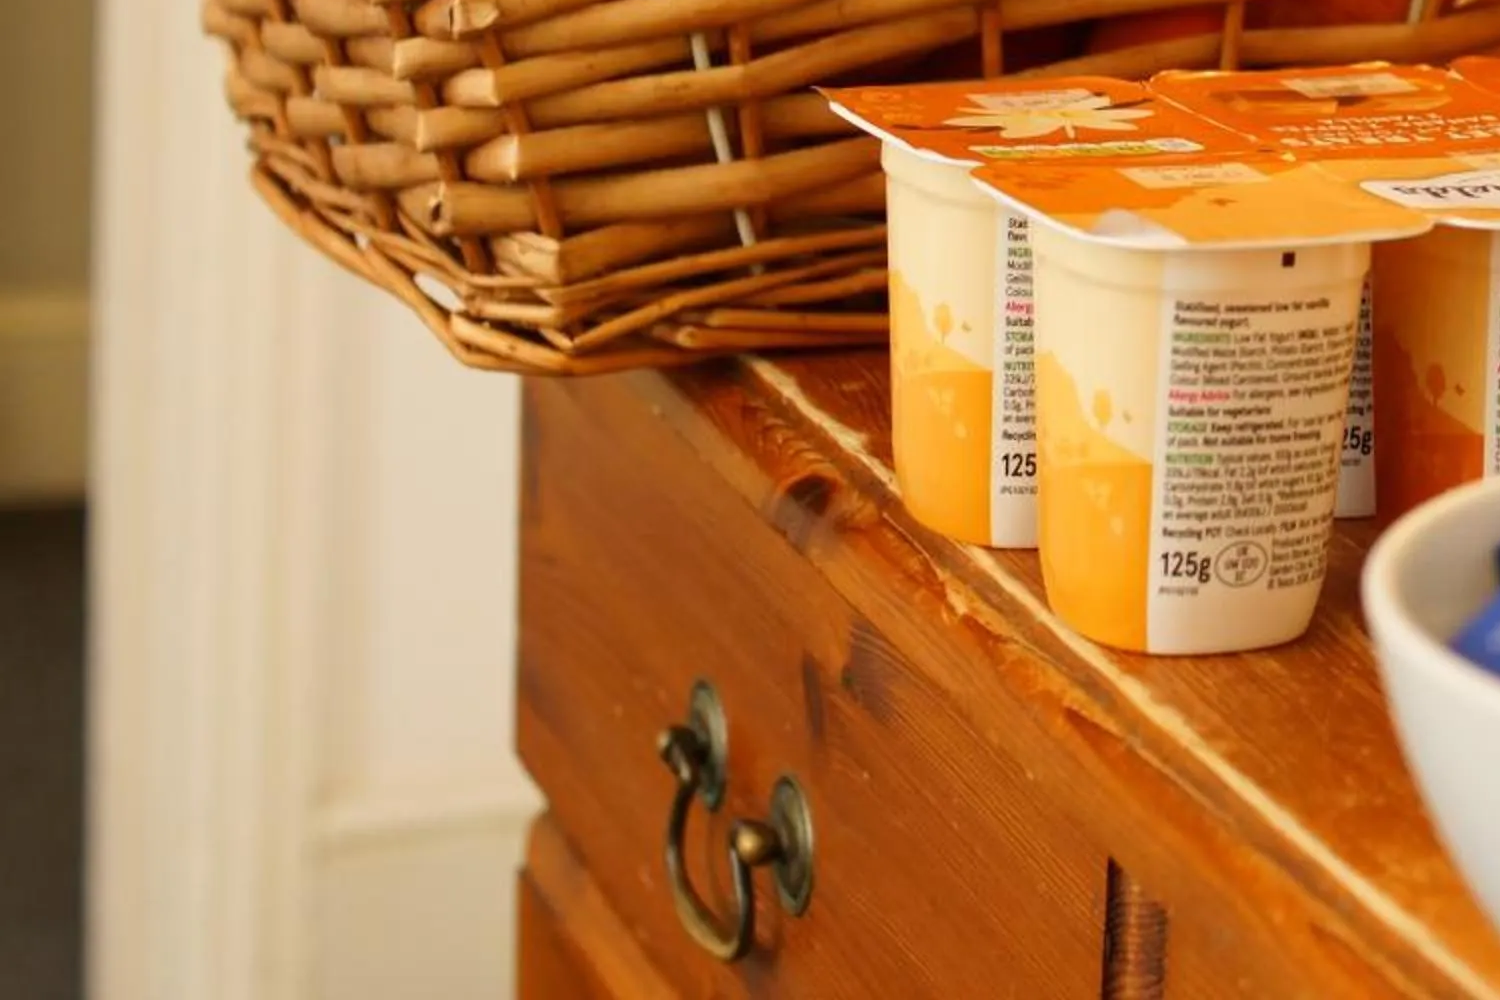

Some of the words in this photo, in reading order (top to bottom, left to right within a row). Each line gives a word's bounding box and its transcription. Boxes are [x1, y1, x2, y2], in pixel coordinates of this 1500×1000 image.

[1005, 286, 1032, 297] Colou
[1005, 316, 1033, 326] Suitab
[1168, 388, 1200, 403] Allergy
[1168, 406, 1205, 417] Suitable
[1207, 405, 1220, 416] for
[1223, 406, 1271, 418] vegetarians
[1211, 423, 1232, 433] Keep
[1002, 429, 1036, 443] Recyclin
[1203, 436, 1219, 446] Not
[1221, 435, 1253, 446] suitable
[1256, 434, 1268, 444] for
[1270, 433, 1291, 443] home
[1342, 425, 1371, 456] 25g
[1002, 452, 1037, 477] 125
[1162, 528, 1202, 541] Recycling
[1161, 552, 1211, 583] 125g
